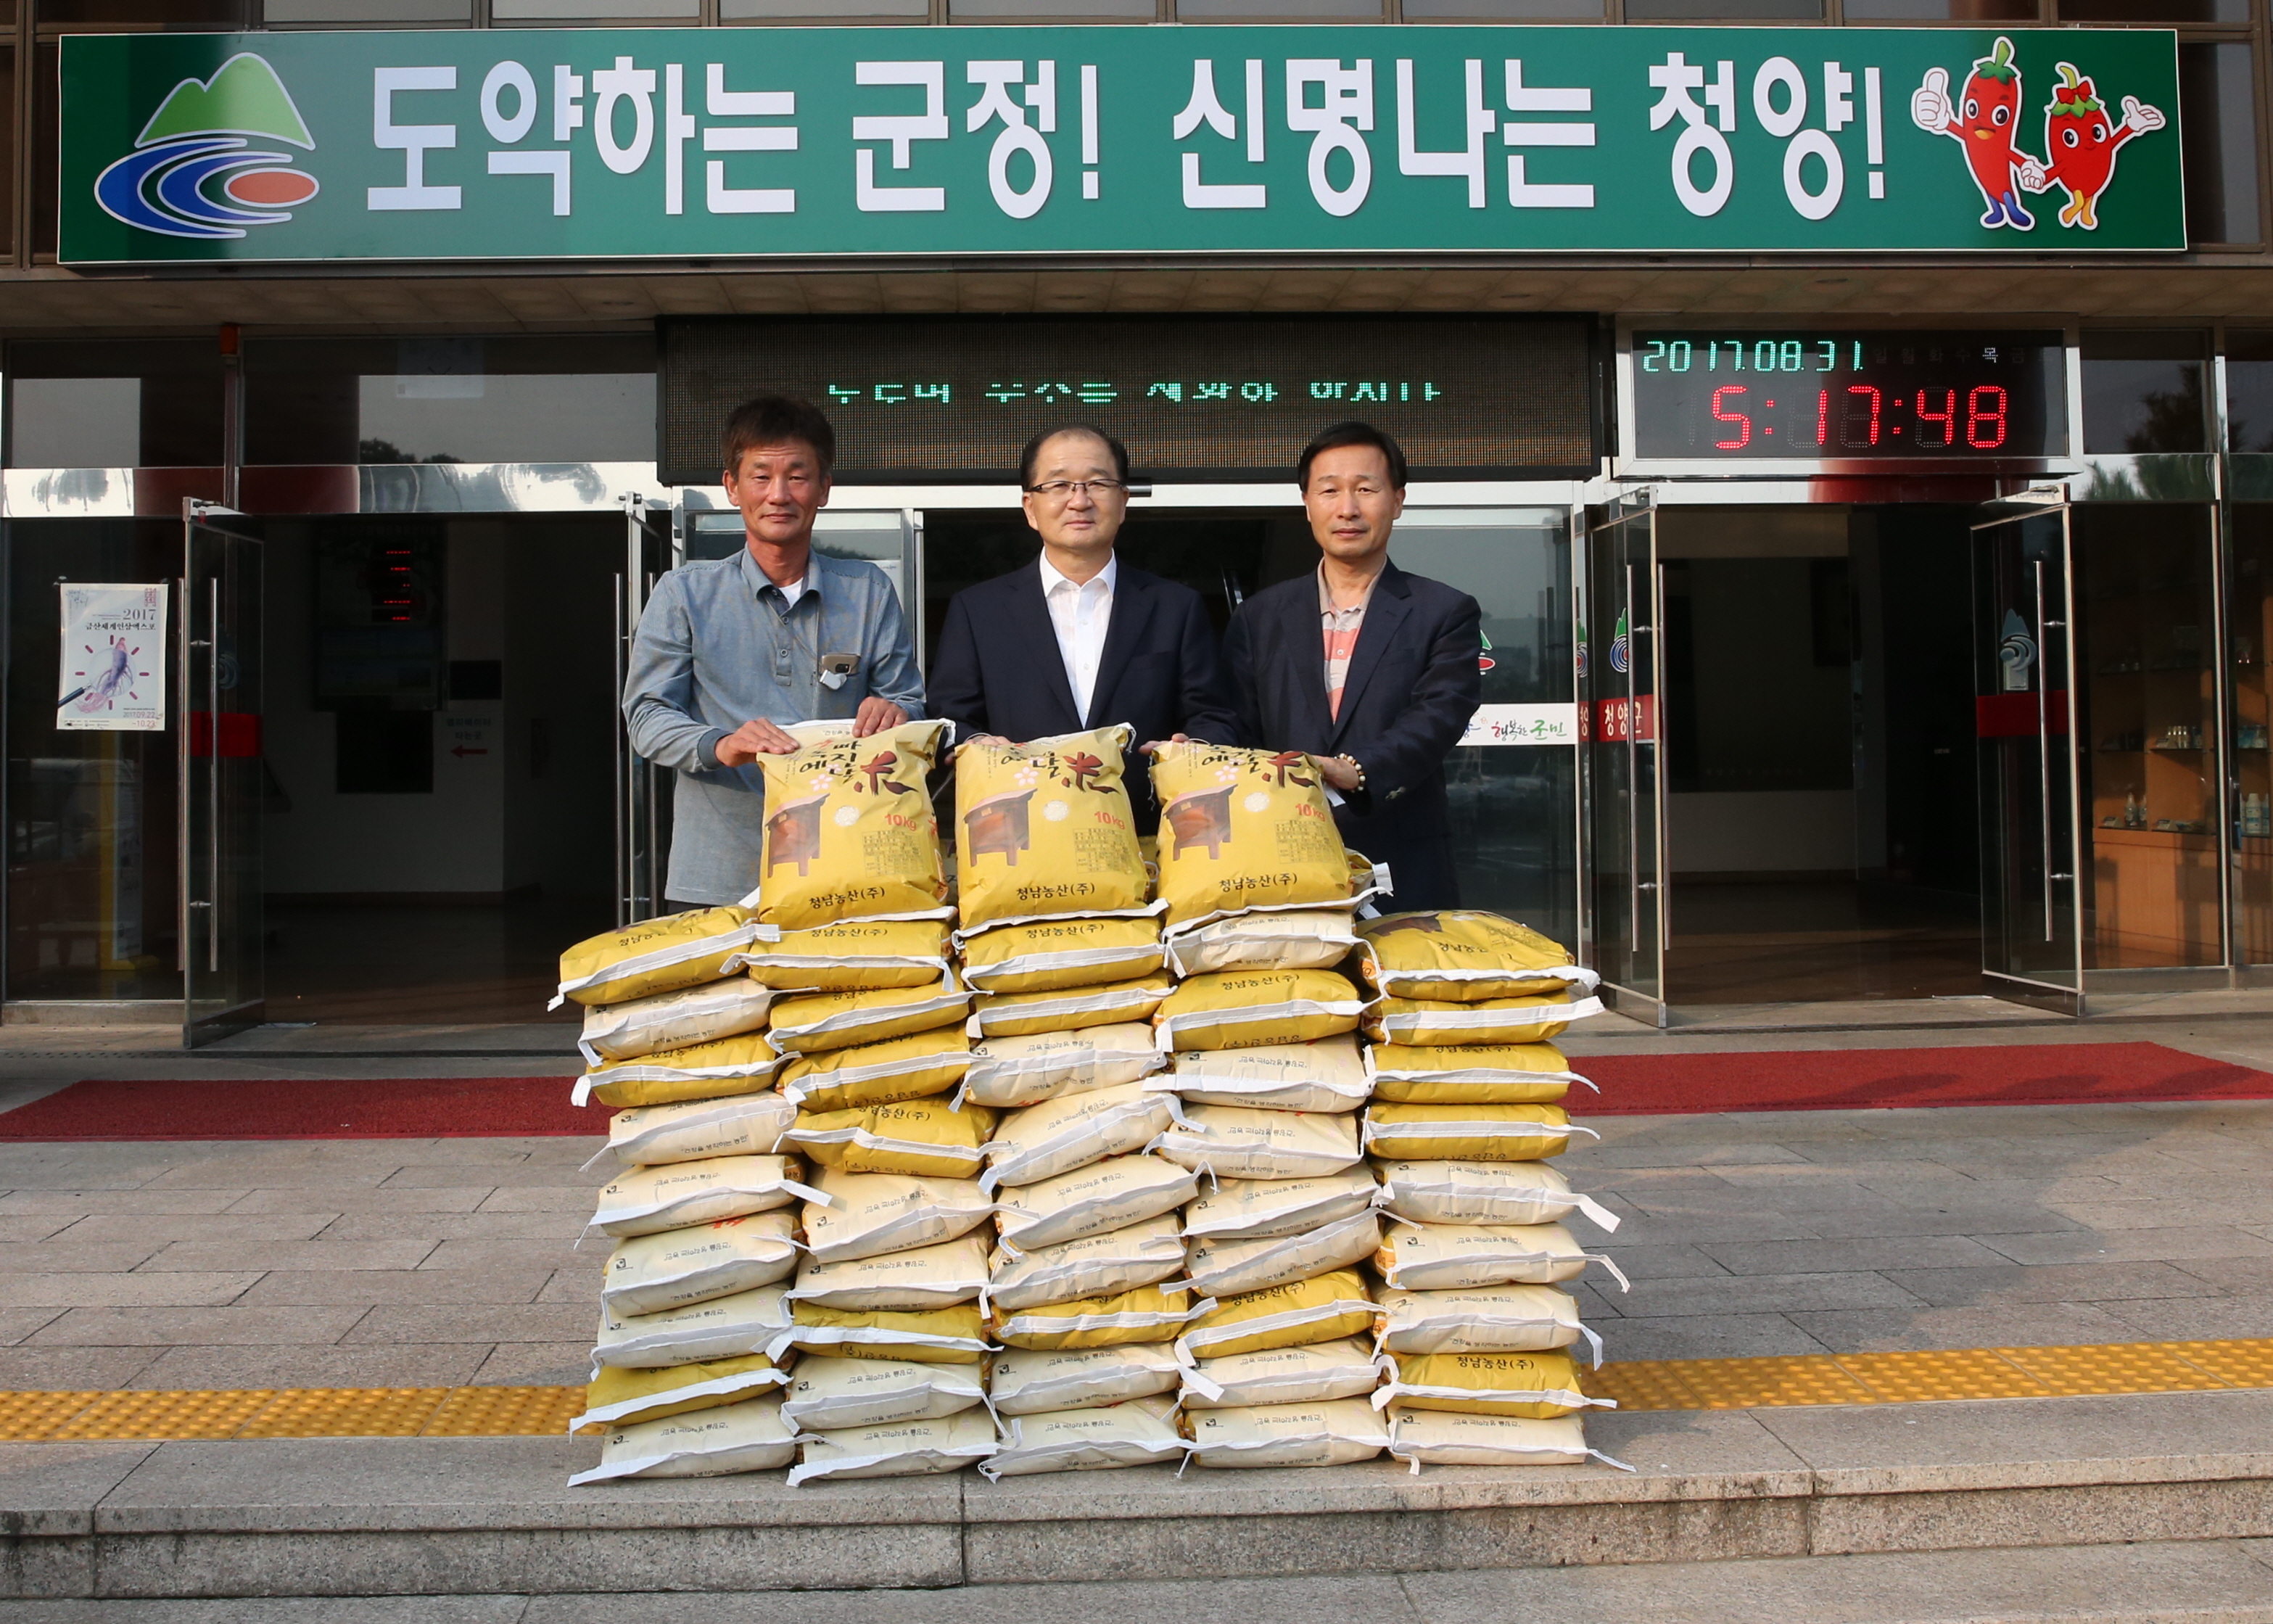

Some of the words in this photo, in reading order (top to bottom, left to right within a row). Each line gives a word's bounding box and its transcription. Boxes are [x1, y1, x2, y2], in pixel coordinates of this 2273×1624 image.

[367, 55, 796, 218] 도약하는
[853, 59, 1100, 220] 군정!
[1173, 58, 1596, 218] 신명나는
[1649, 52, 1886, 220] 청양!
[1711, 384, 2008, 449] 5:17:48
[123, 609, 156, 620] 2017
[1016, 882, 1096, 901] 청남농산(주)
[1218, 873, 1298, 893] 청남농산(주)
[809, 886, 886, 909] 청남농산(주)
[1026, 923, 1105, 939] 청남농산(주)
[1221, 974, 1300, 990] 청남농산(주)
[1456, 1356, 1534, 1370] 청남농산(주)
